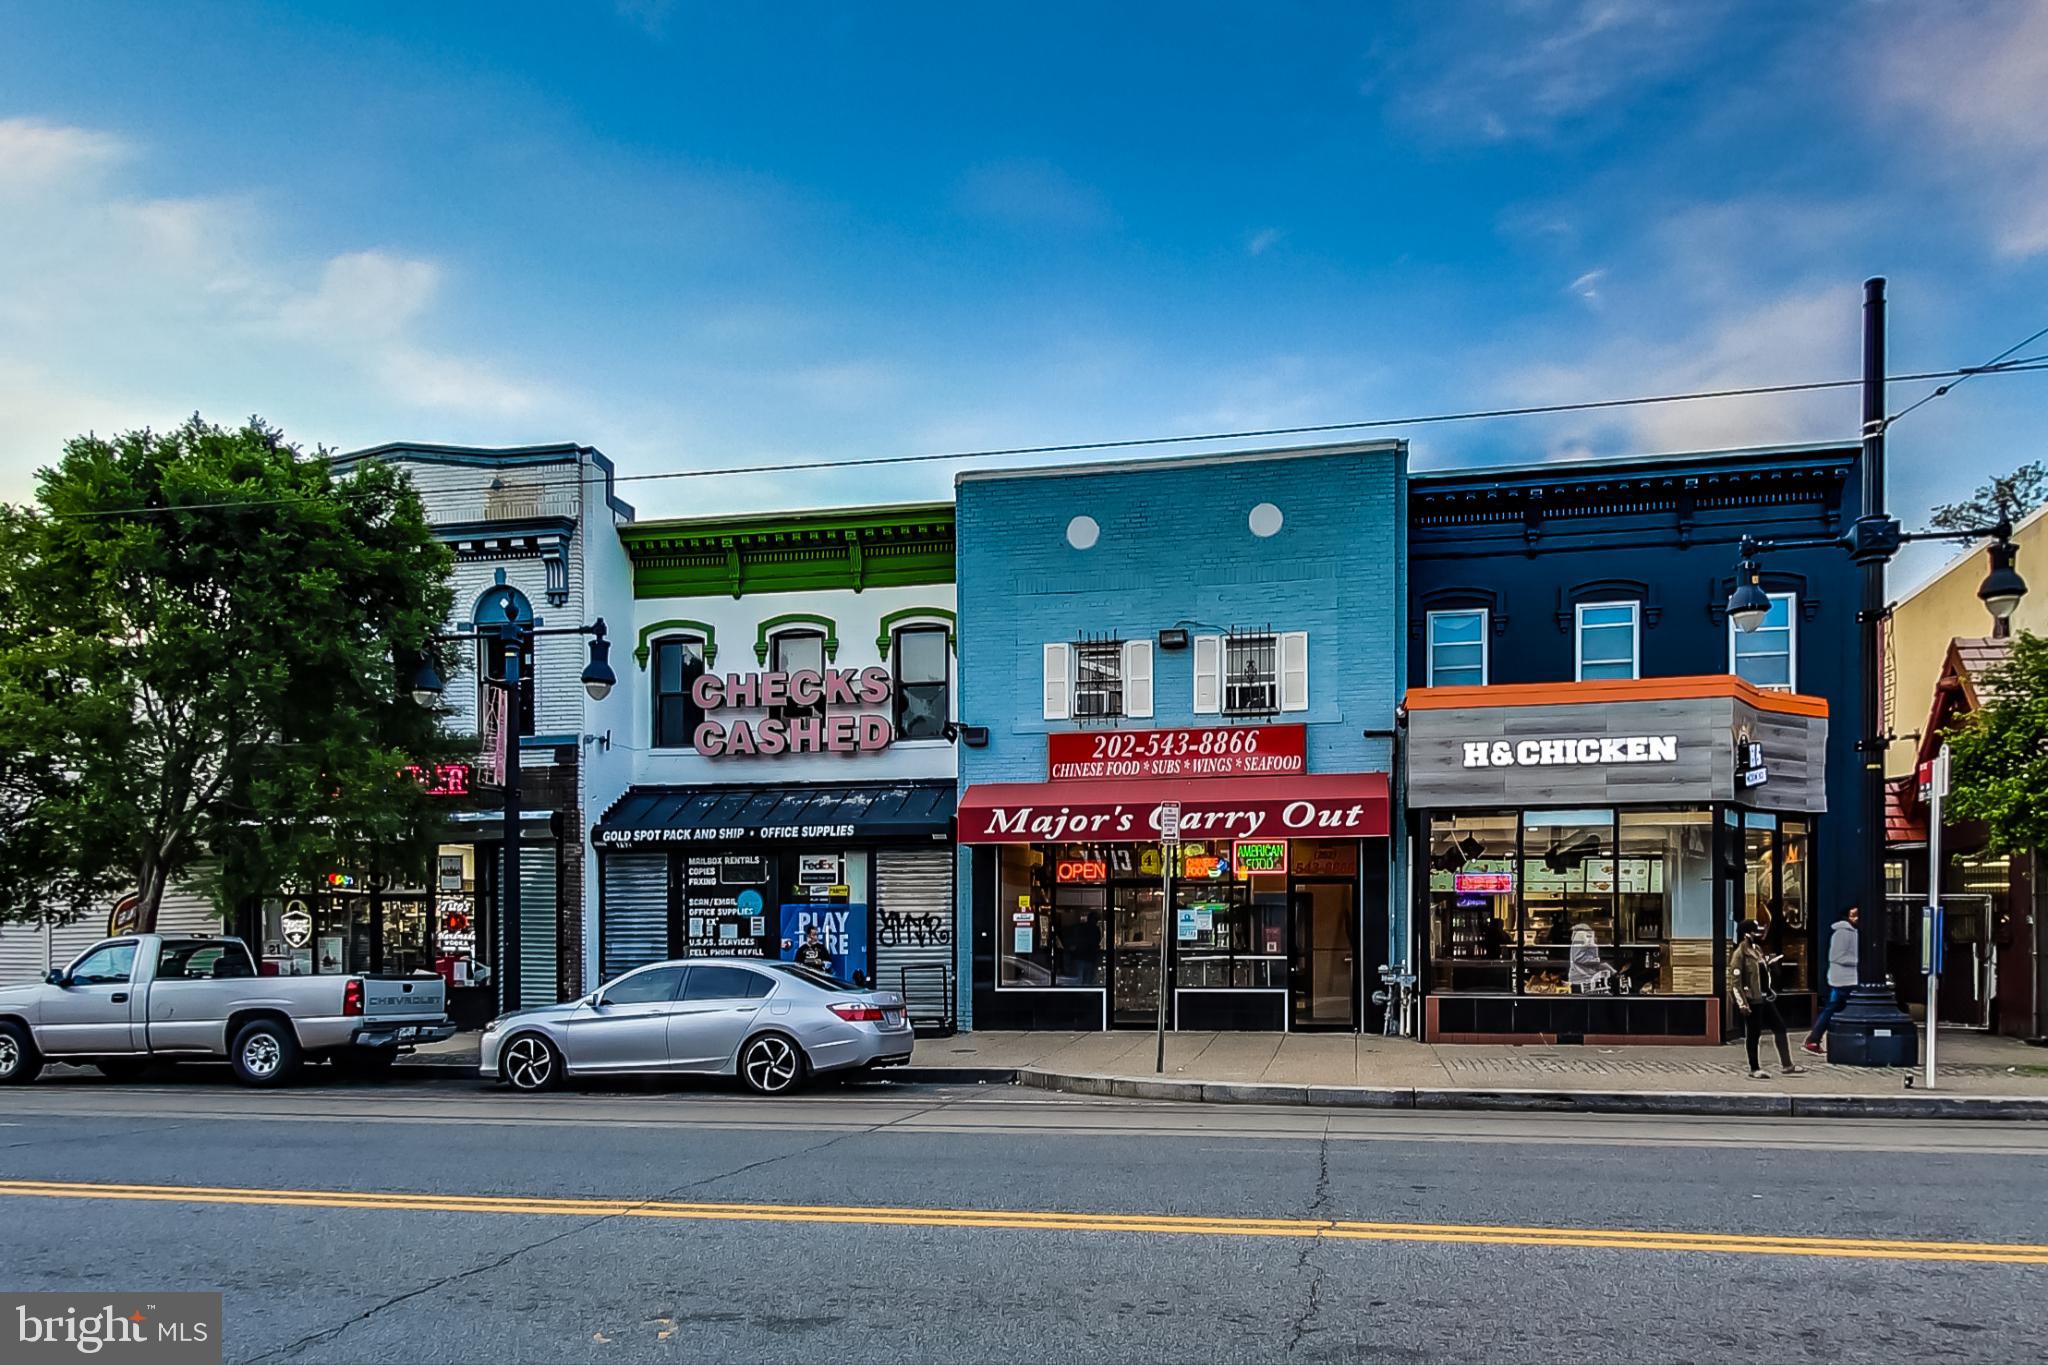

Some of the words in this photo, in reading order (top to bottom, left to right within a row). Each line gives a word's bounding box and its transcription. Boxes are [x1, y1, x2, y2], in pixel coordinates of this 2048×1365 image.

[693, 668, 893, 709] CHECKS
[693, 714, 893, 757] CASHED
[1092, 730, 1260, 759] 202-543-8866
[1052, 762, 1104, 778] CHINESE
[1106, 760, 1140, 776] FOOD
[1151, 758, 1181, 775] SUBS
[1192, 757, 1233, 774] WINGS
[1244, 755, 1302, 771] SEAFOOD
[984, 806, 1133, 840] Major's
[1282, 801, 1364, 829] Out
[602, 831, 632, 842] GOLD
[633, 830, 661, 841] SPOT
[663, 829, 692, 840] PACK
[693, 829, 717, 840] AND
[718, 828, 745, 839] SHIP
[760, 827, 800, 839] OFFICE
[801, 825, 855, 838] SUPPLIES
[1237, 844, 1284, 857] AMERICAN
[689, 857, 722, 865] MAILBOX
[725, 856, 760, 864] RENTALS
[803, 860, 834, 870] FedEx
[1246, 857, 1273, 870] FOOD
[689, 867, 716, 875] COPIES
[1059, 863, 1106, 879] OPEN
[689, 908, 715, 916] OFFICE
[717, 908, 754, 916] SUPPLIES
[798, 912, 850, 934] PLAY
[369, 997, 441, 1006] CHEVROLET
